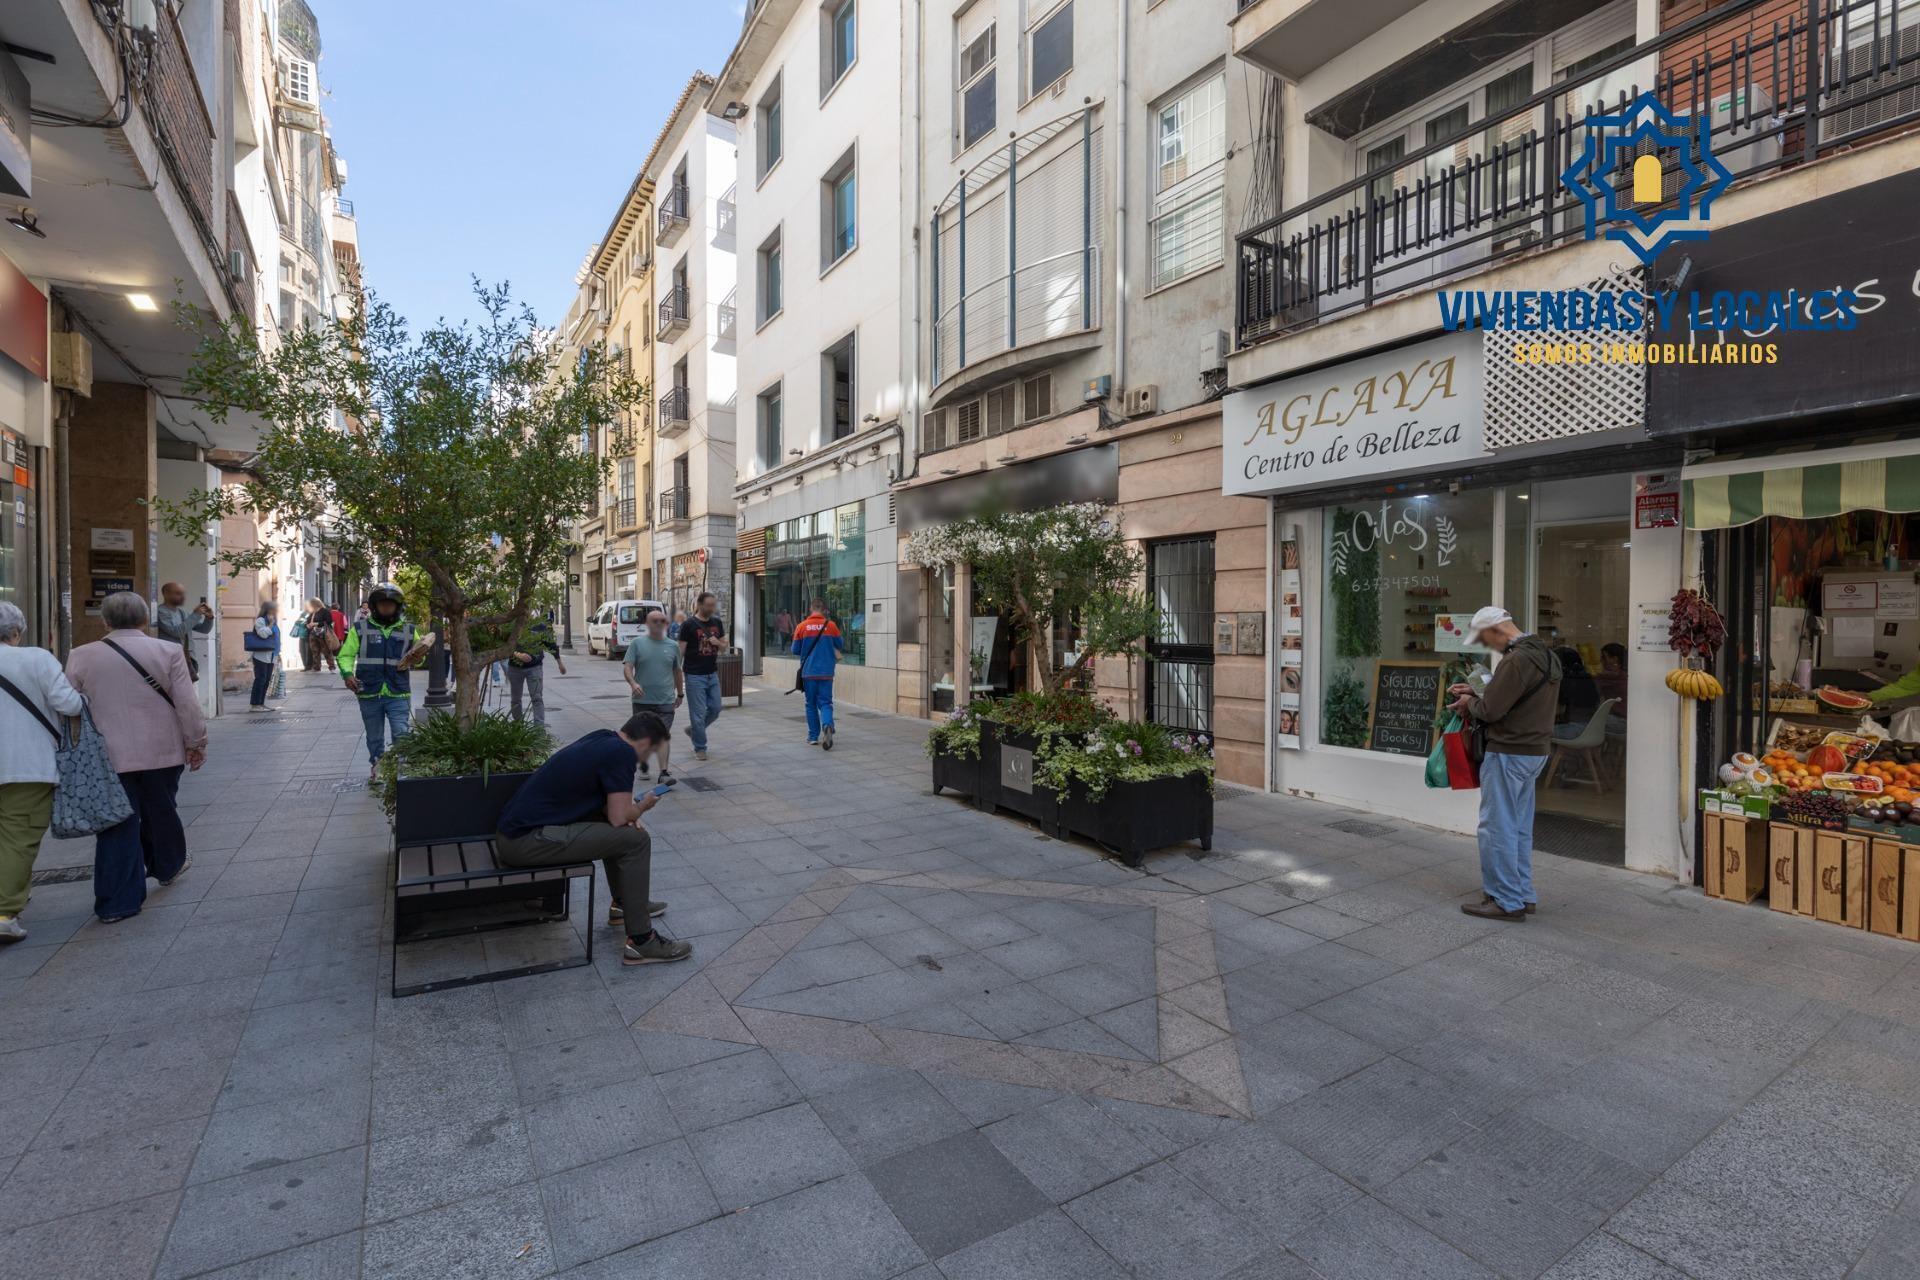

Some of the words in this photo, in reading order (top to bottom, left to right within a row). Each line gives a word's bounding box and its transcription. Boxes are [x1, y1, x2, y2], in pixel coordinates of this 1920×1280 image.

[1243, 355, 1458, 446] AGLAYA
[1244, 447, 1315, 480] Centro
[1322, 435, 1349, 465] de
[1356, 420, 1461, 459] Belleza
[1639, 495, 1675, 505] Alarma
[1352, 500, 1428, 552] Citas
[1402, 690, 1430, 700] REDES
[1380, 729, 1422, 750] Booksy
[1787, 812, 1823, 826] Mifra
